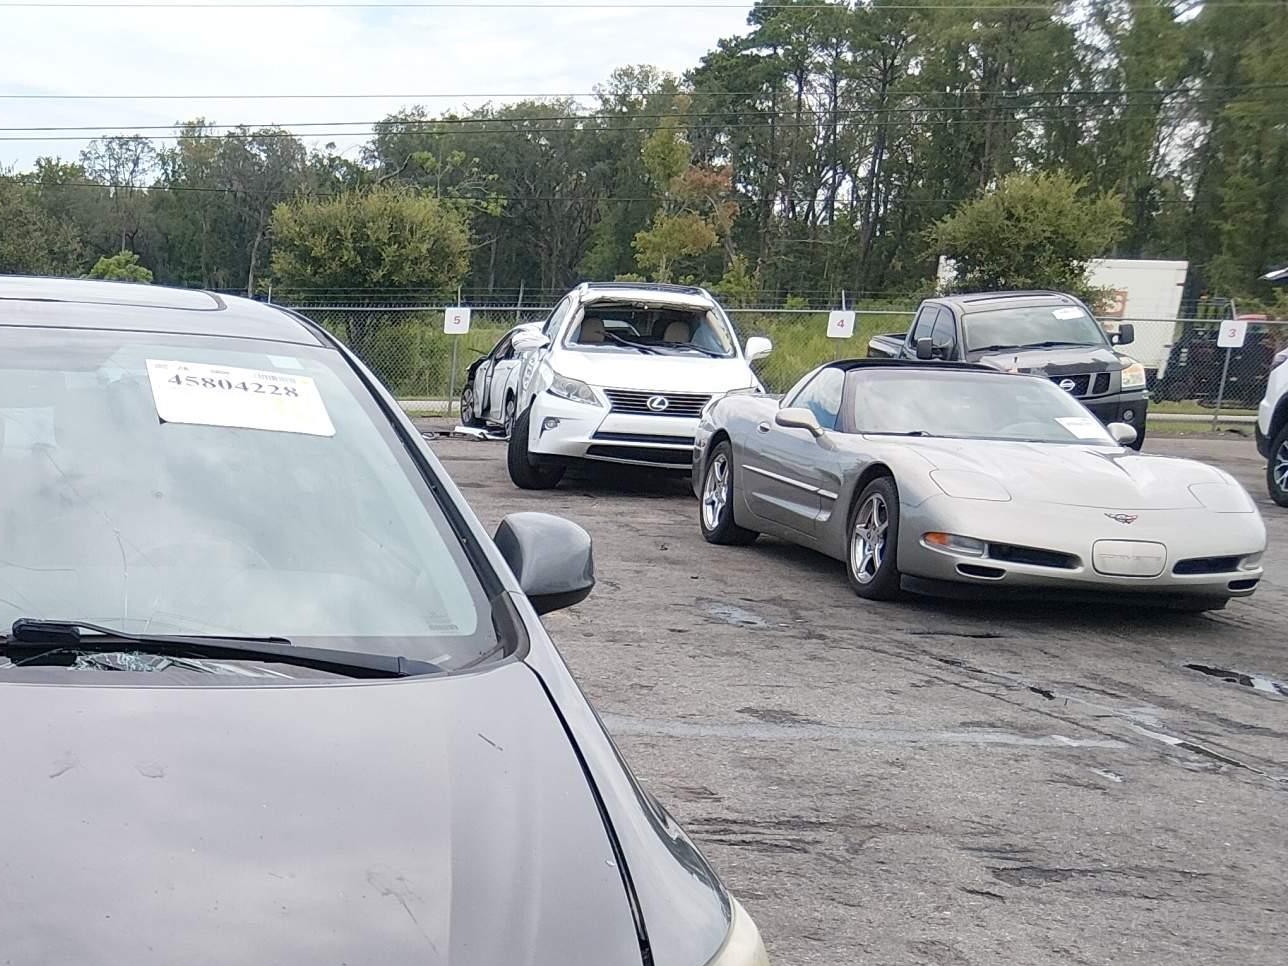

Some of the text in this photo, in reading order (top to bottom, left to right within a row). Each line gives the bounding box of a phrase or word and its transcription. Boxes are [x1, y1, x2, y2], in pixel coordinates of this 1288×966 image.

[453, 315, 461, 325] 5
[836, 319, 845, 328] 4
[1228, 328, 1236, 338] 3
[168, 373, 299, 398] 45804228
